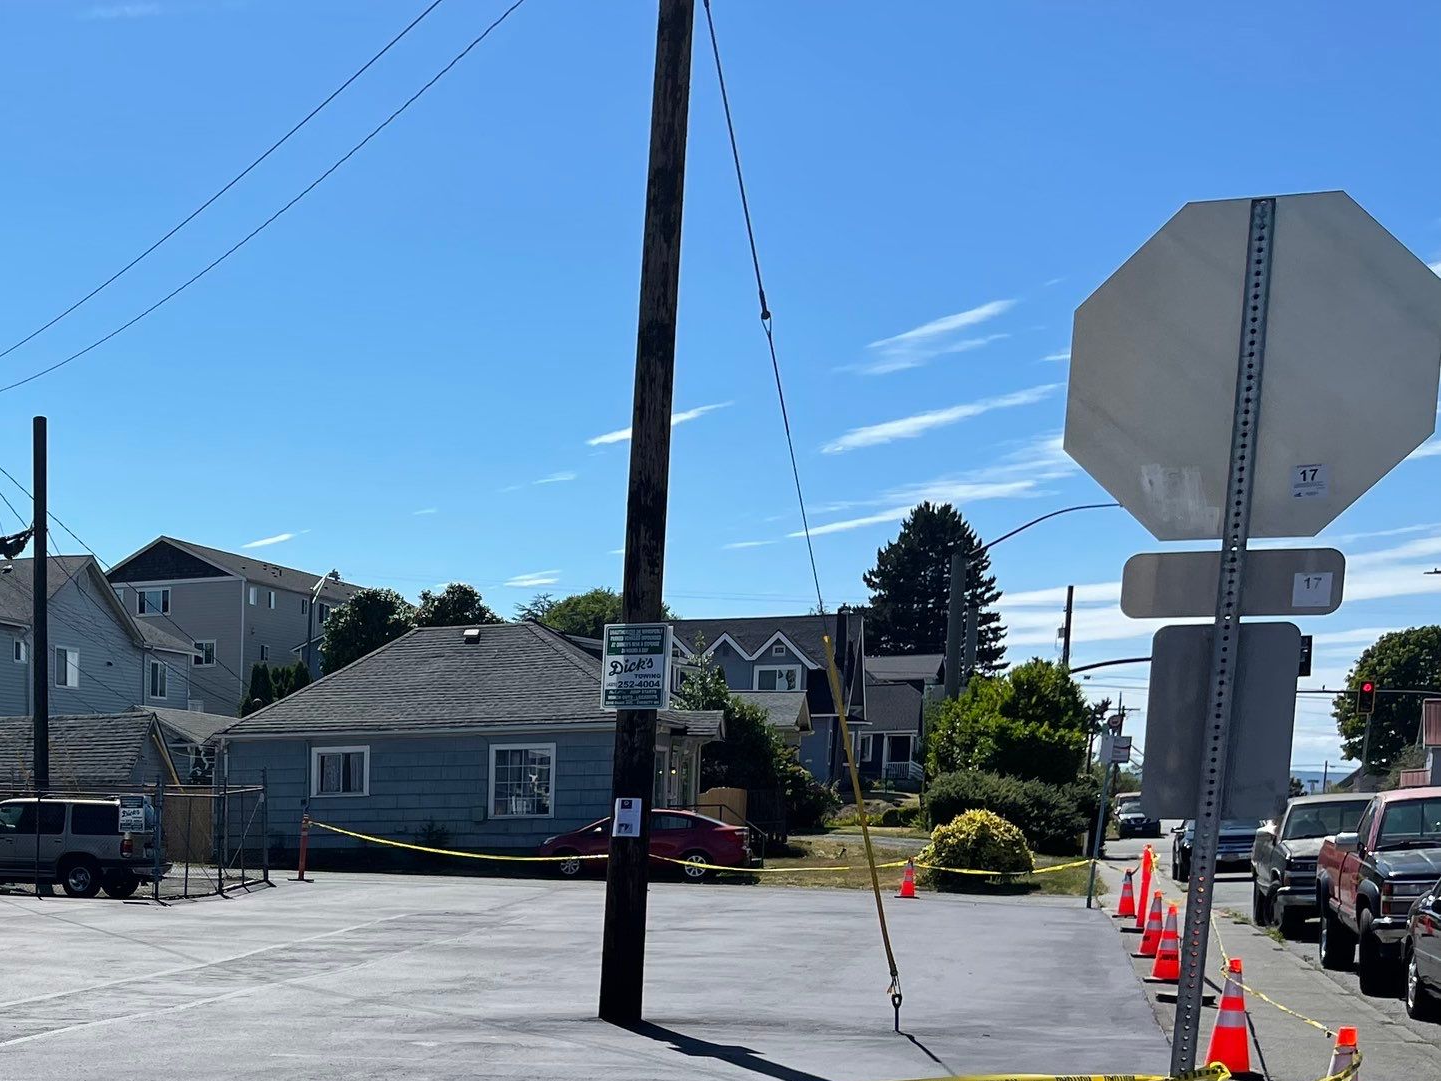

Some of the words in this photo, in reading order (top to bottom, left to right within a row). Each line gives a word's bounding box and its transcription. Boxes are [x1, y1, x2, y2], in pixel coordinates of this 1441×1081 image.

[1300, 468, 1319, 482] 17
[1303, 576, 1322, 589] 17
[609, 658, 654, 676] Dick's
[617, 680, 660, 688] 252-4004
